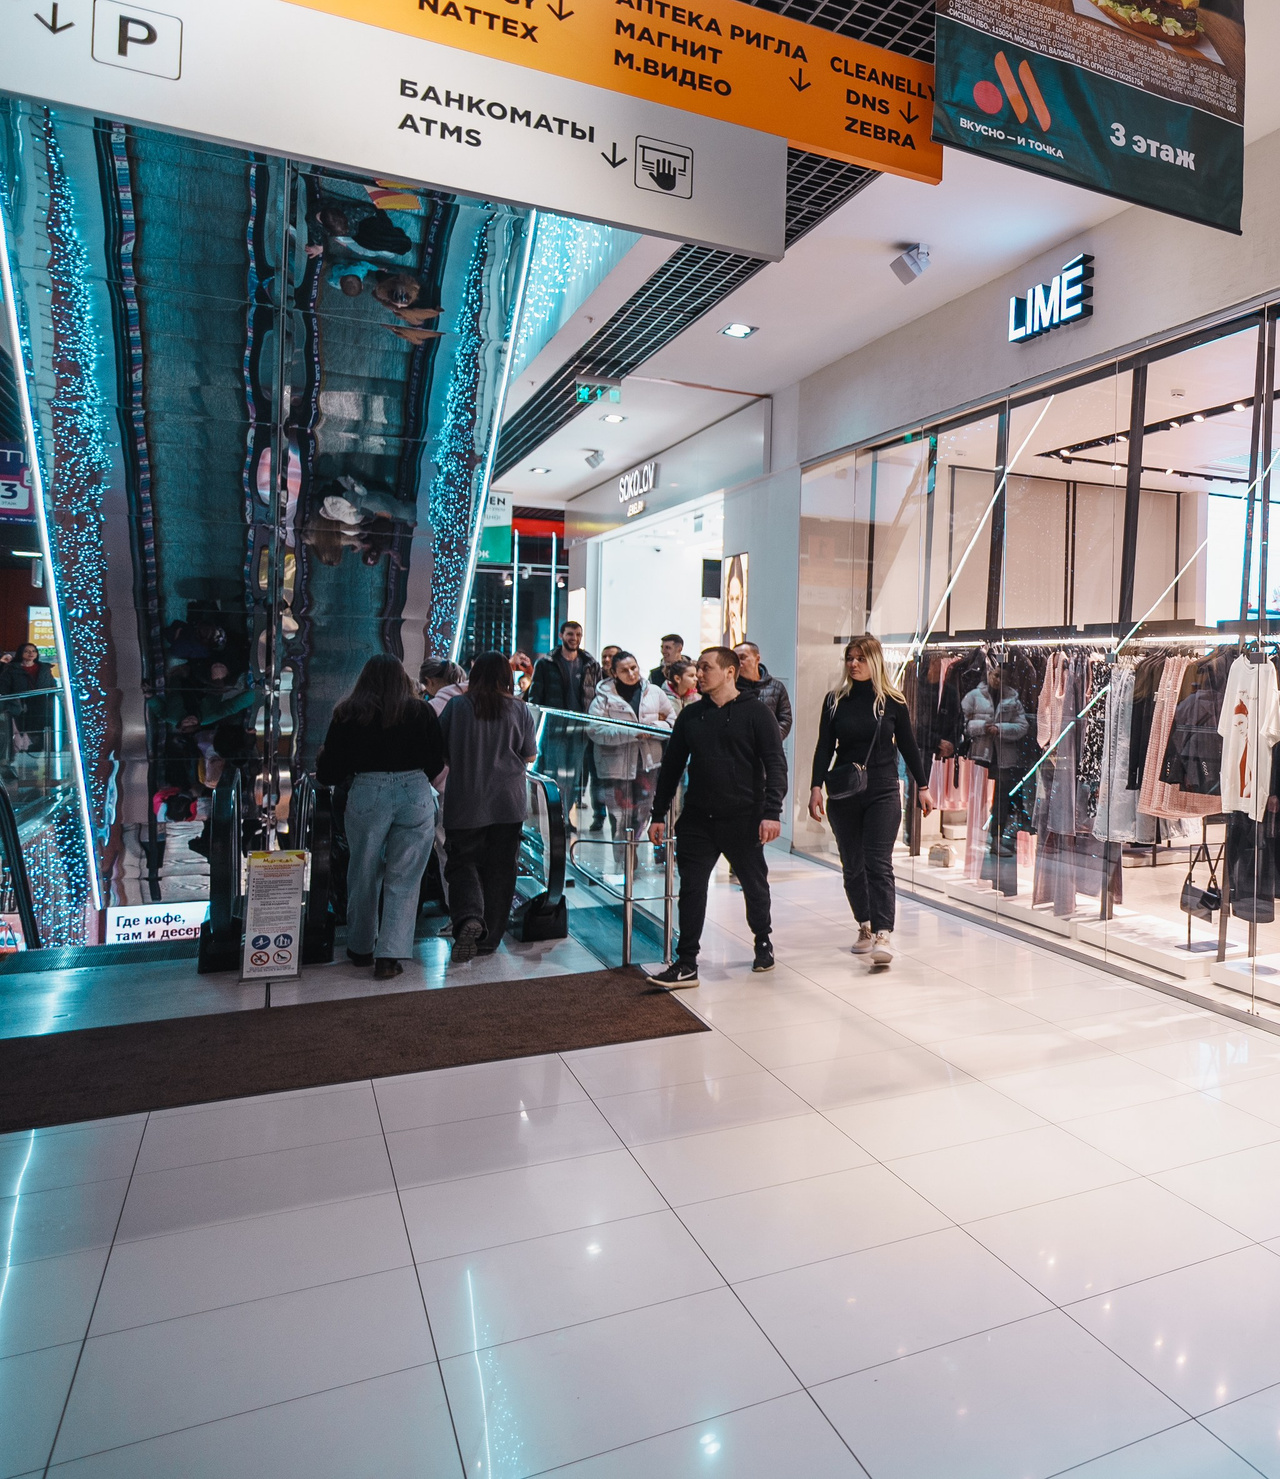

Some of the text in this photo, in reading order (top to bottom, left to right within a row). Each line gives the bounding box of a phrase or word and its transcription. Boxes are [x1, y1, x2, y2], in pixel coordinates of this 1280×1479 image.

[118, 15, 157, 57] P
[418, 0, 539, 43] NATTEX
[615, 0, 808, 63] АПТЕКА РИГЛА
[615, 18, 722, 65] МАГНИТ
[613, 48, 732, 97] М.ВИДЕО
[830, 56, 935, 101] CLEANELLY
[400, 78, 595, 143] БАНКОМАТЫ
[846, 89, 890, 115] DNS
[398, 113, 482, 147] ATMS
[844, 116, 916, 150] ZEBRA
[959, 117, 1005, 140] ВКУСНО
[1028, 139, 1065, 159] ТОЧКА
[1110, 122, 1196, 171] 3 этаж
[1009, 253, 1086, 342] LIMÉ
[116, 913, 186, 928] Где кофе,
[116, 932, 142, 941] там
[147, 930, 156, 939] и
